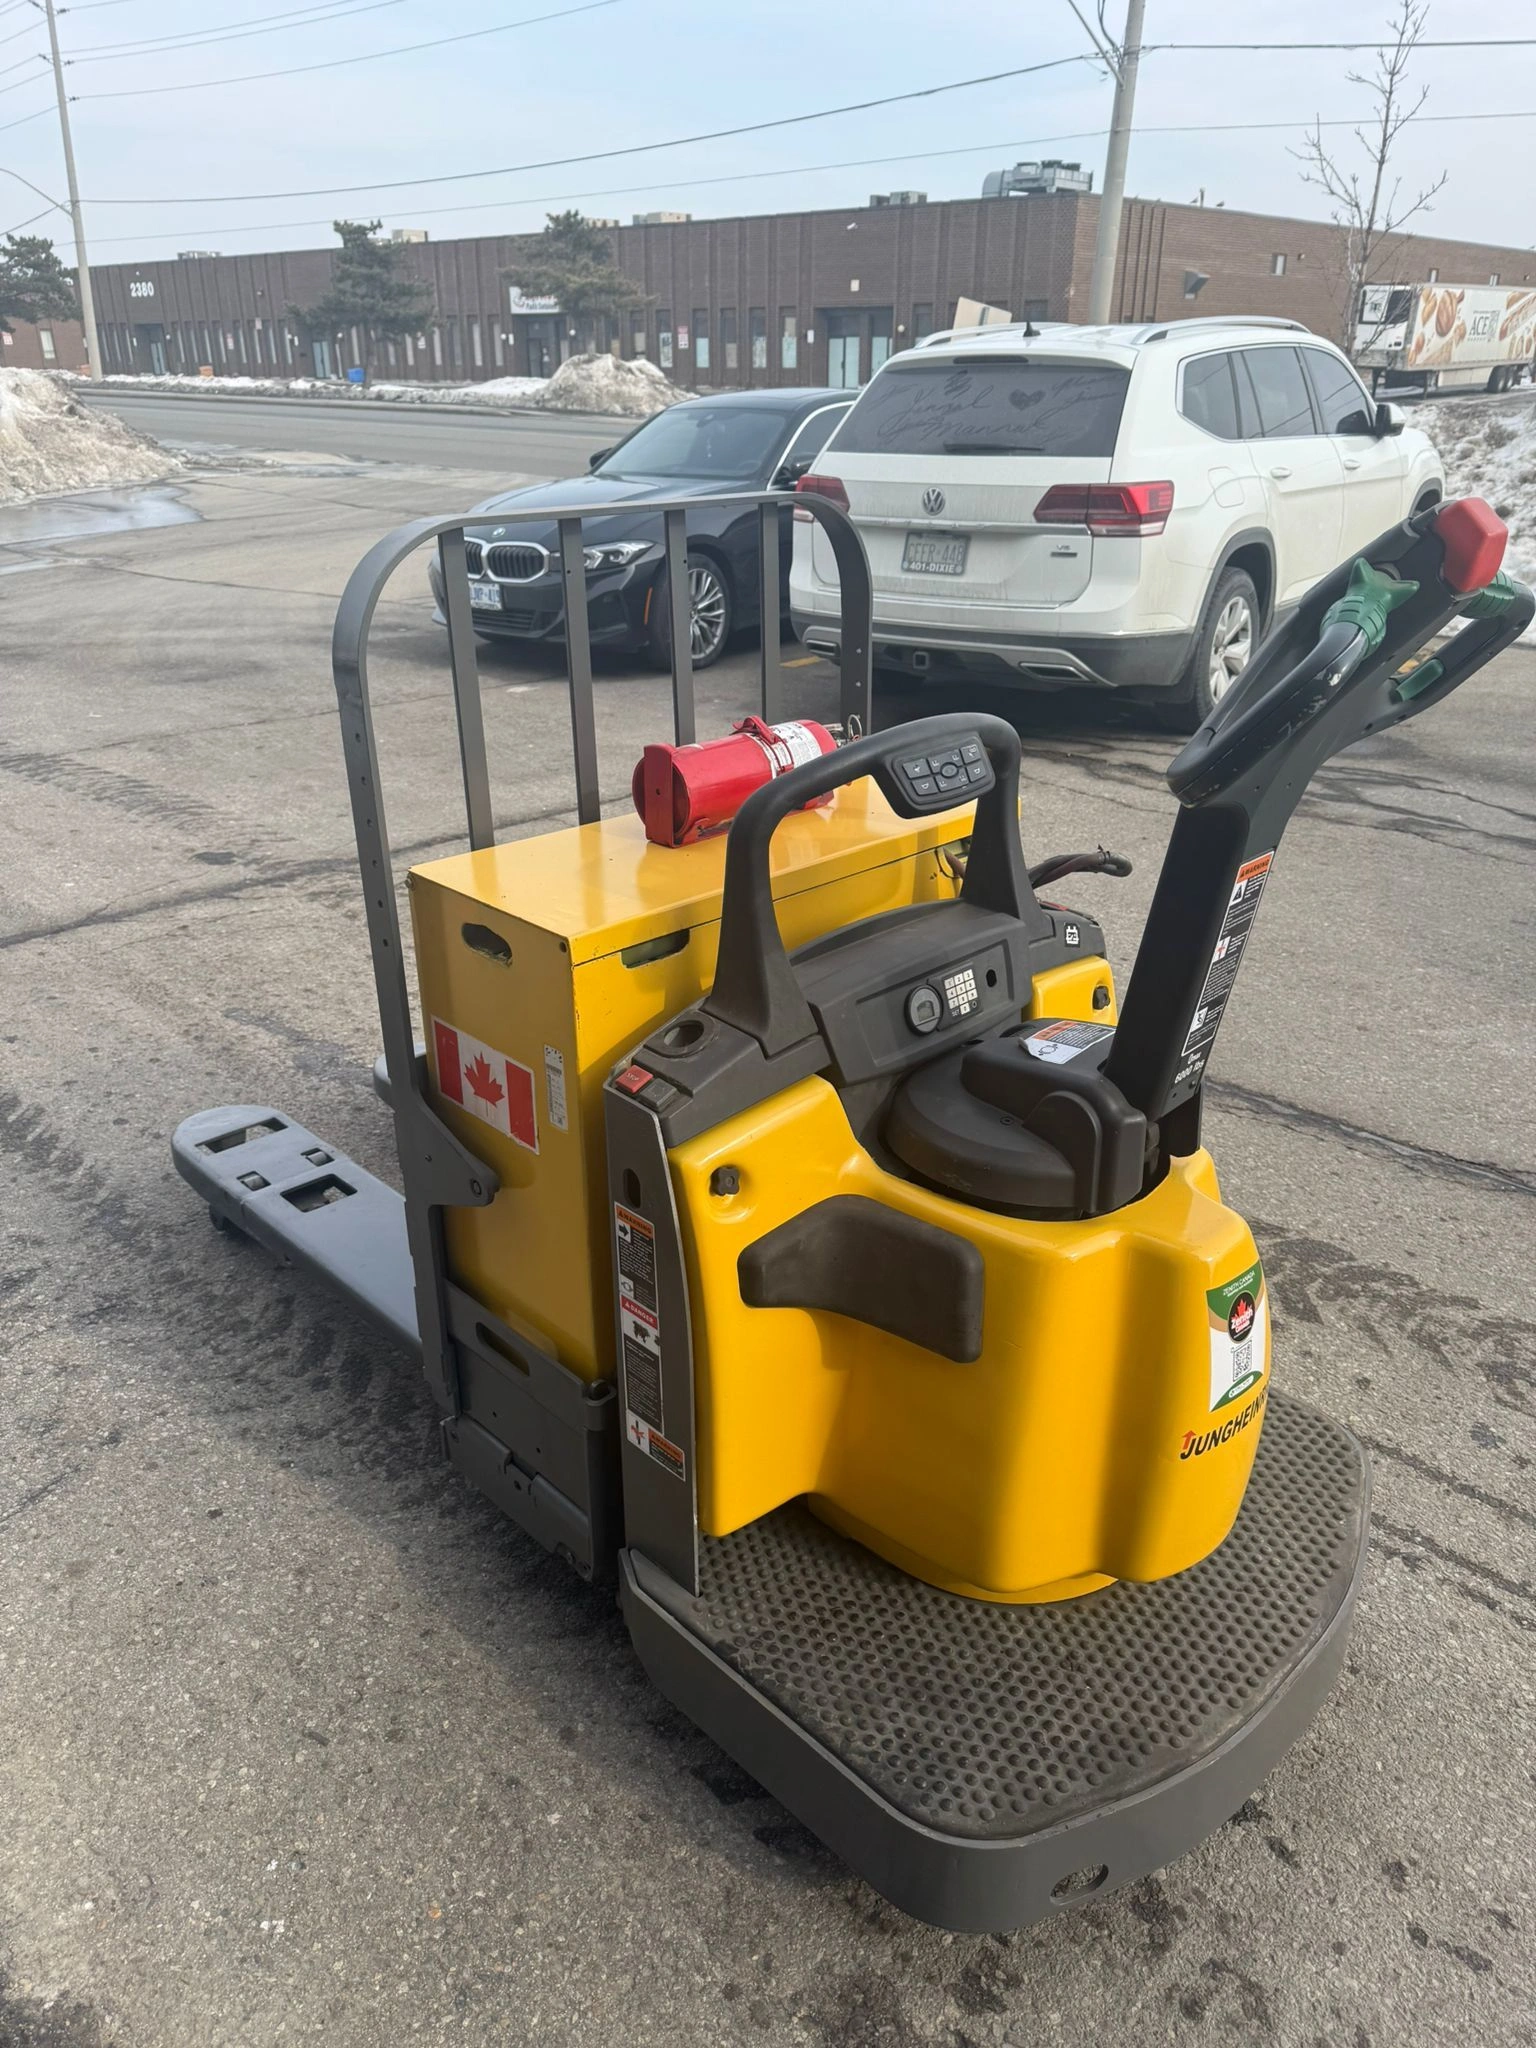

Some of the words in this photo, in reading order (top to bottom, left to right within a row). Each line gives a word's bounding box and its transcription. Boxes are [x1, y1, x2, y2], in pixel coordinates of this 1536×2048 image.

[130, 281, 154, 298] 2380
[1469, 315, 1490, 336] ACE
[910, 560, 956, 574] 401-DIXIE
[1223, 1281, 1240, 1296] ZENITH
[1239, 1270, 1256, 1286] CANADA
[630, 1303, 654, 1323] DANGER
